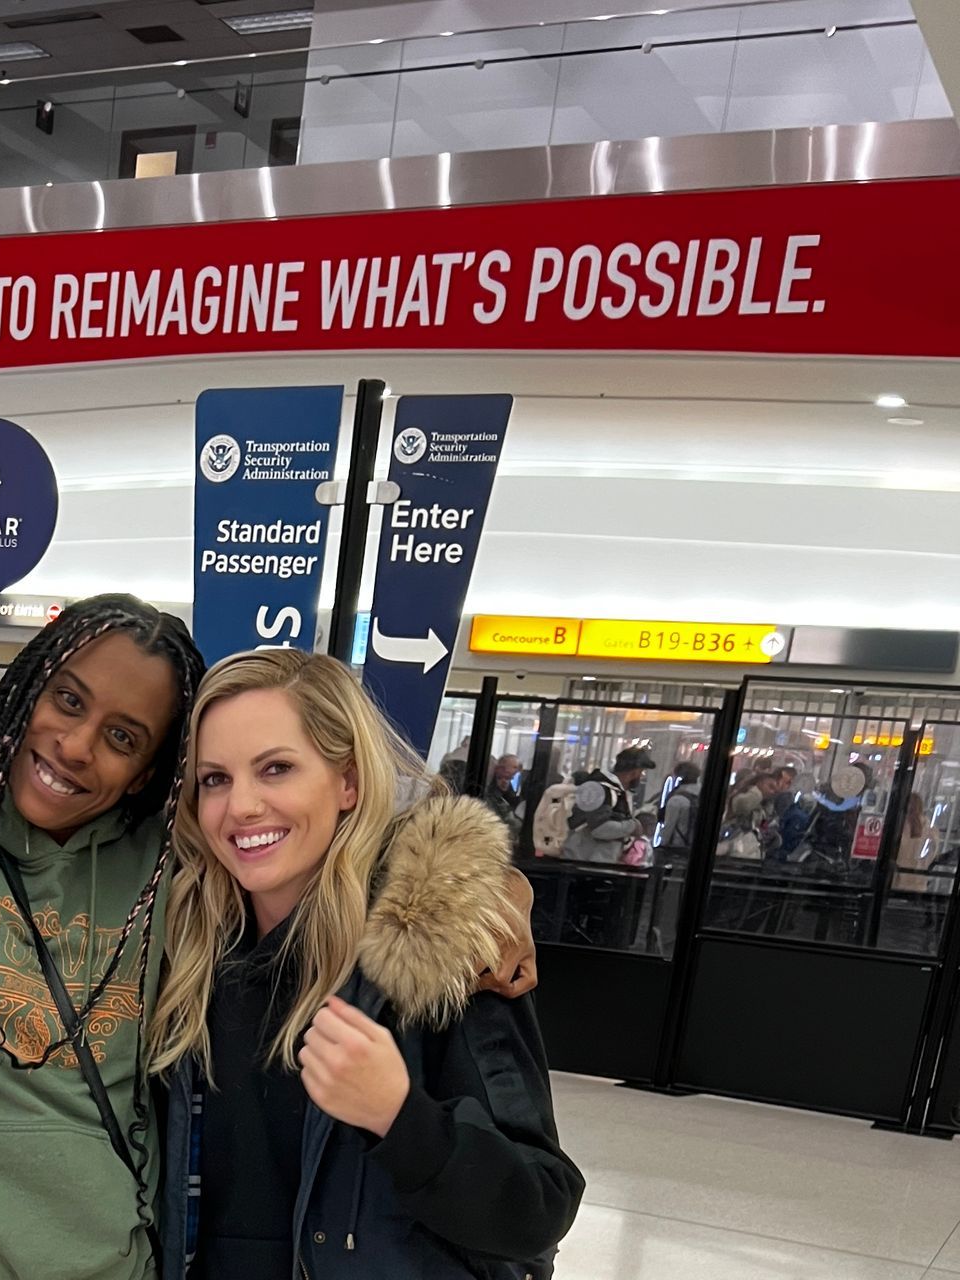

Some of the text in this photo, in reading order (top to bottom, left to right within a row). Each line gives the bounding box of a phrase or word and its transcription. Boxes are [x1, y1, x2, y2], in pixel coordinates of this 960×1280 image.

[50, 261, 305, 339] REIMAGINE
[320, 250, 511, 330] WHAT'S
[525, 234, 826, 322] POSSIBLE.
[245, 440, 330, 455] Transportation
[429, 442, 468, 453] Security
[430, 432, 498, 443] Transportation
[244, 454, 292, 469] Security
[427, 452, 497, 463] Administration
[242, 467, 329, 480] Administration
[390, 499, 475, 530] Enter
[215, 519, 322, 544] Standard
[389, 534, 464, 564] Here
[200, 549, 318, 579] Passenger
[492, 631, 551, 645] Concourse
[553, 626, 568, 645] B
[638, 630, 736, 653] B19-B36
